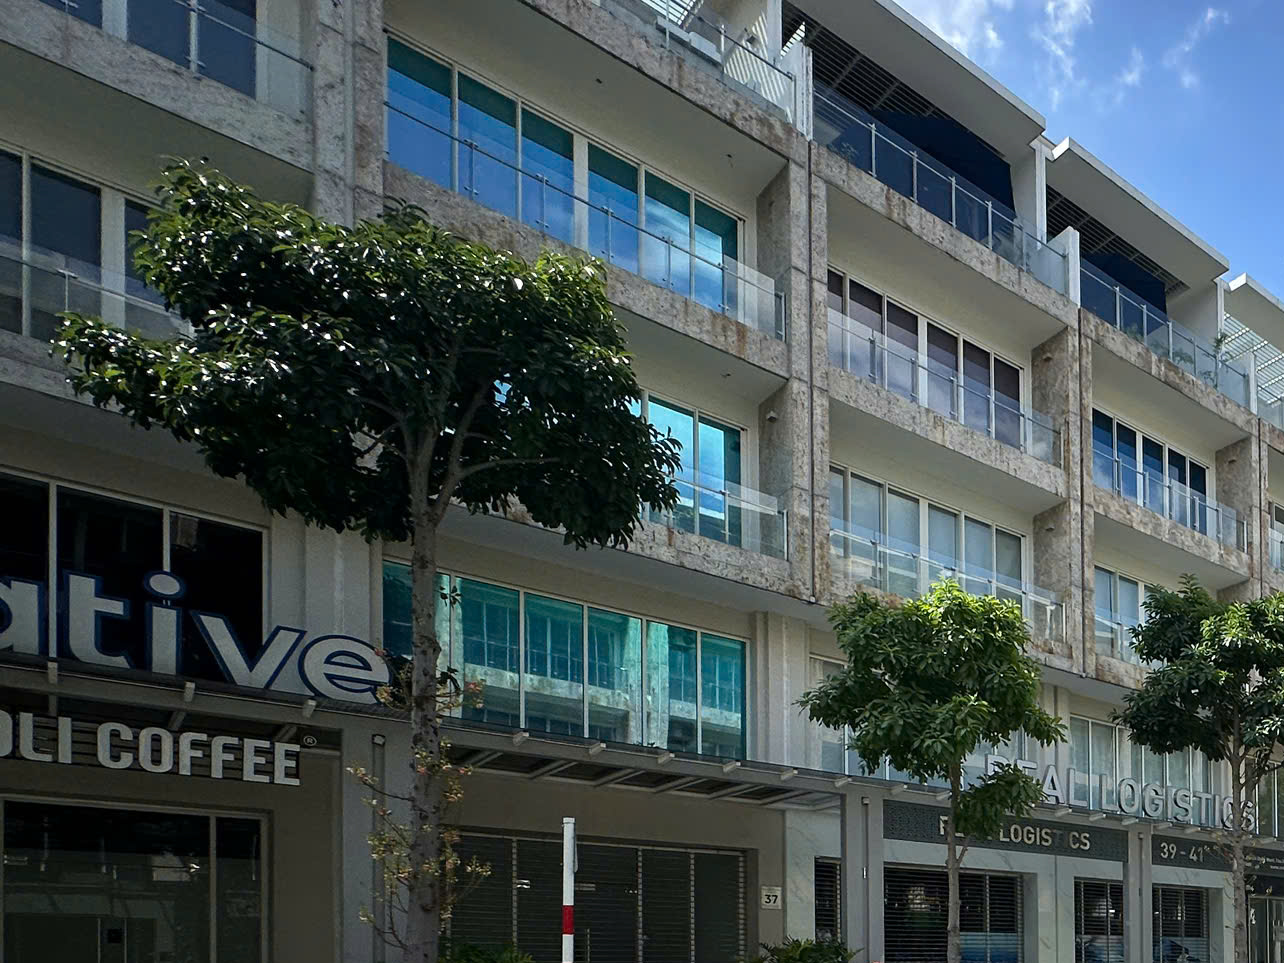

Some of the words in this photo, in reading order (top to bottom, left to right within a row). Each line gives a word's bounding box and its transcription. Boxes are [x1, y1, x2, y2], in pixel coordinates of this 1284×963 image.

[96, 721, 301, 787] COFFEE
[1160, 842, 1176, 859] 39
[764, 894, 778, 904] 37
